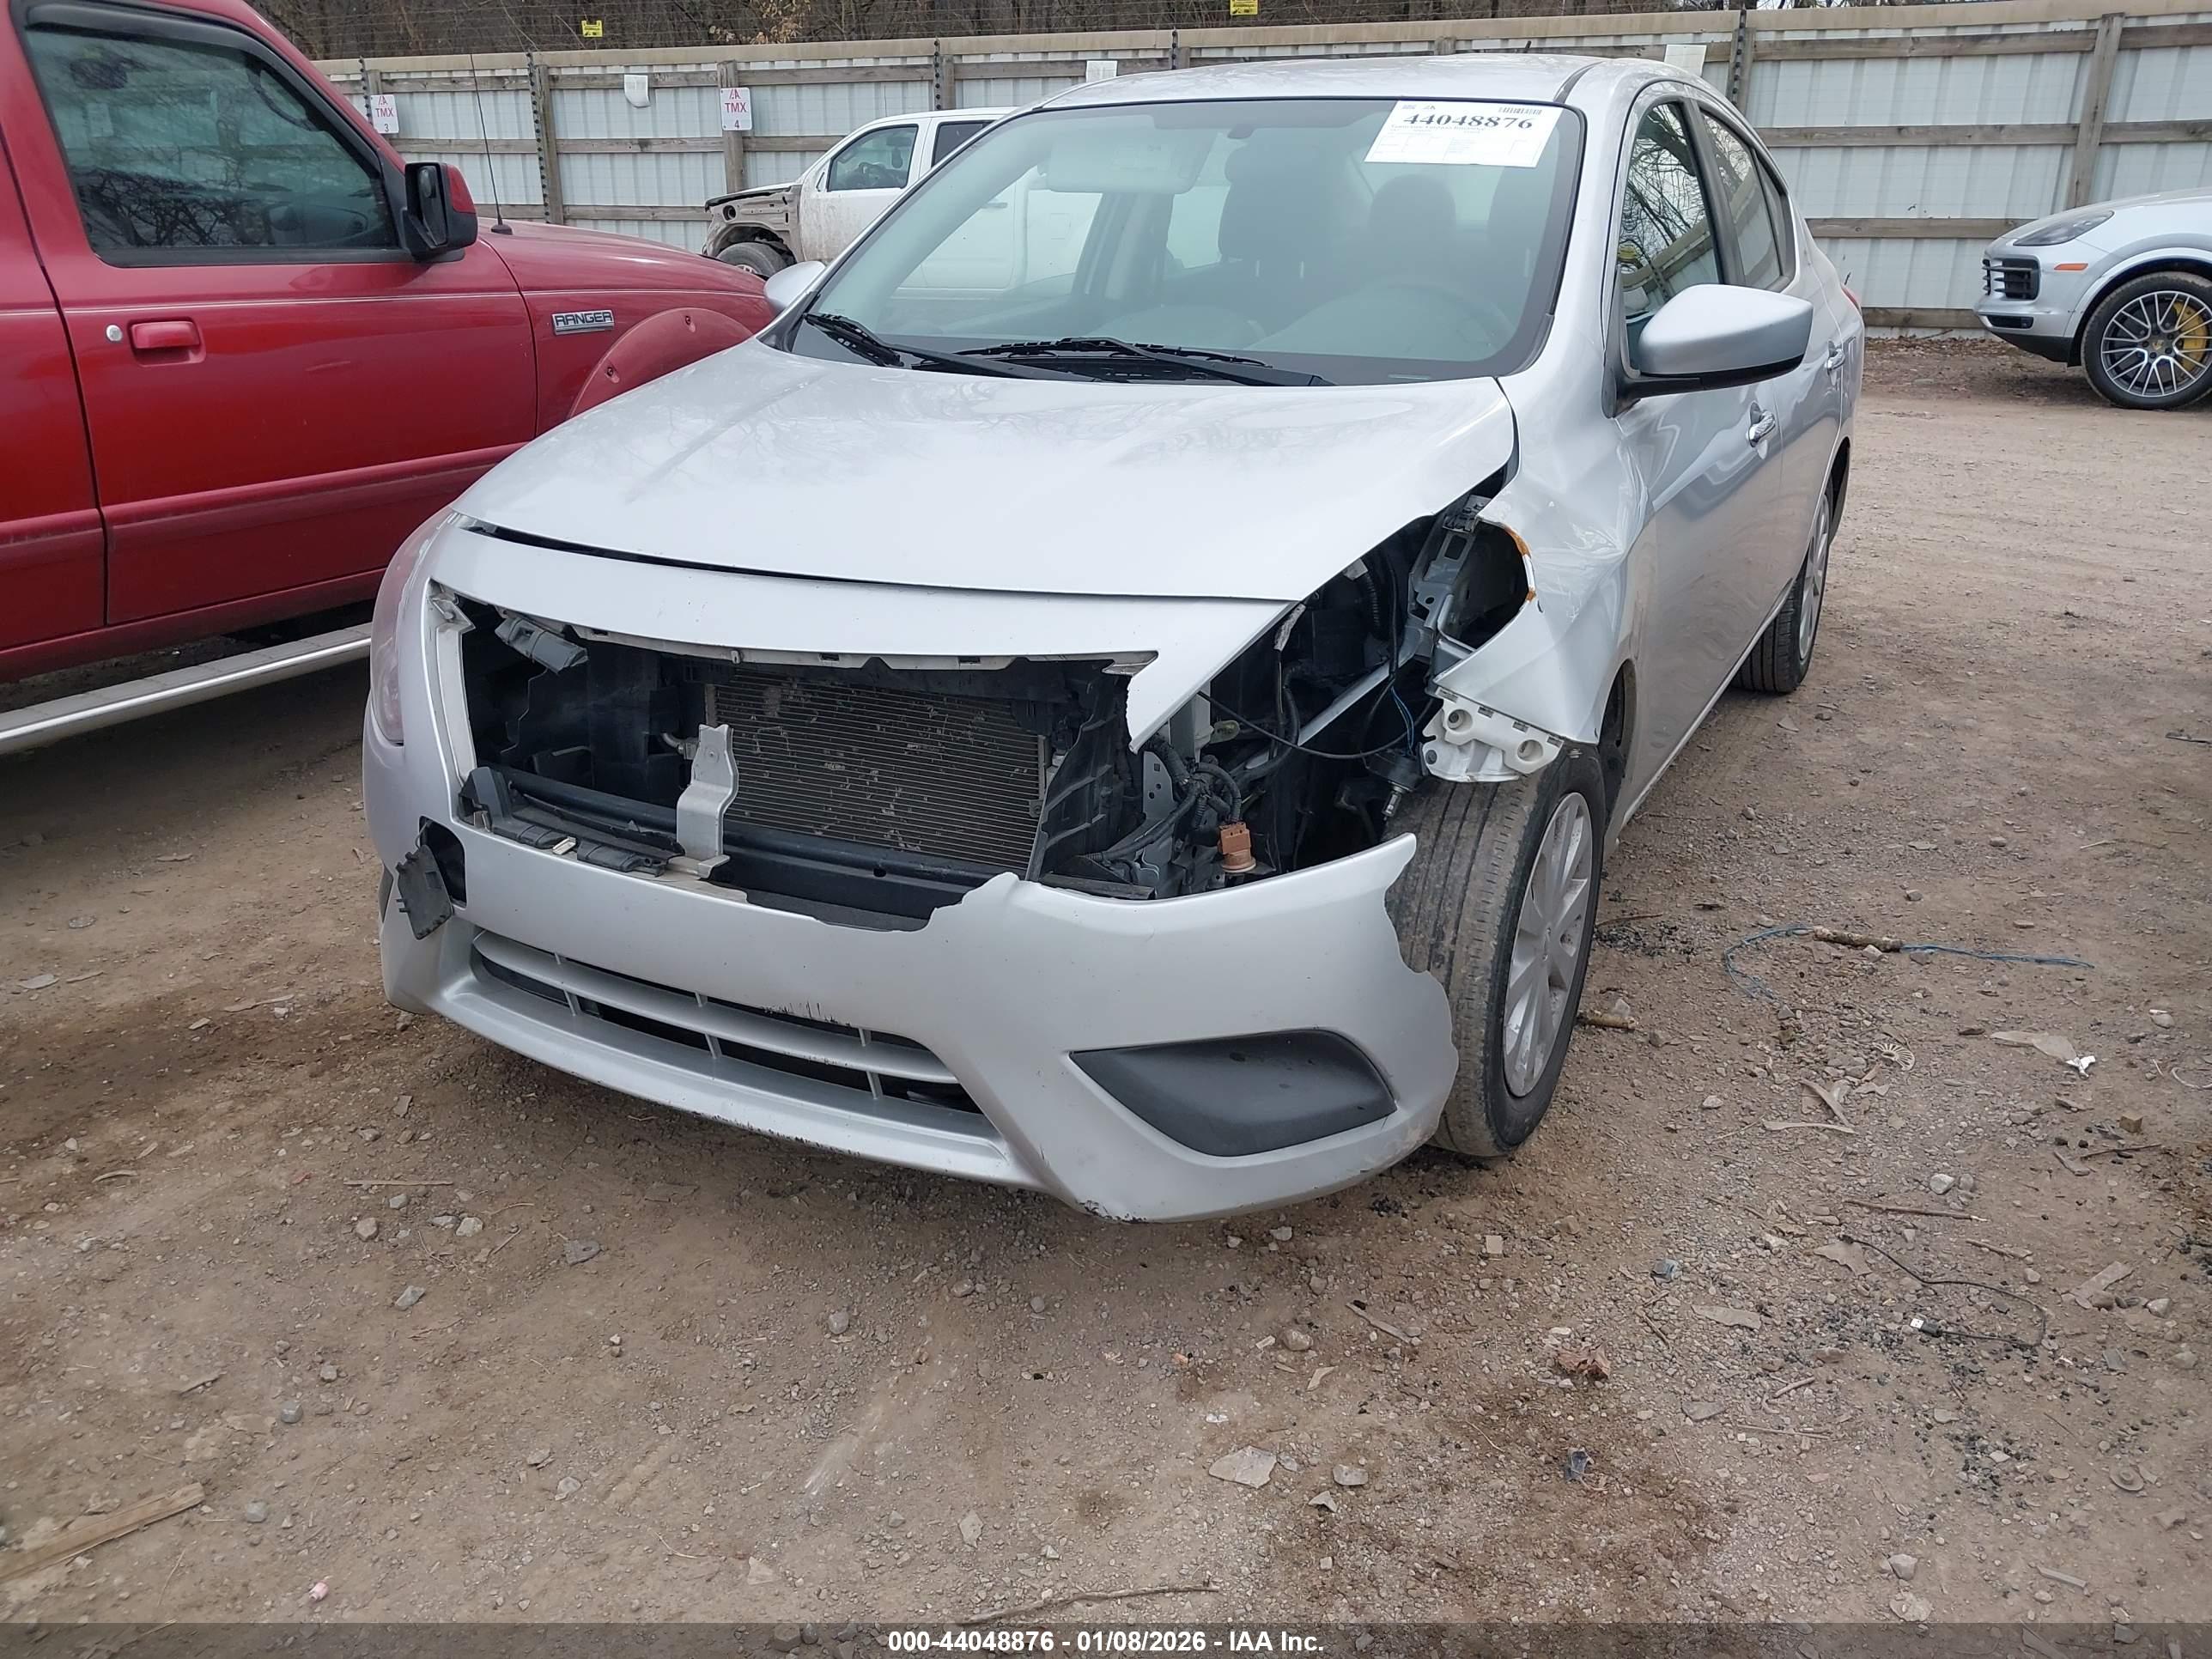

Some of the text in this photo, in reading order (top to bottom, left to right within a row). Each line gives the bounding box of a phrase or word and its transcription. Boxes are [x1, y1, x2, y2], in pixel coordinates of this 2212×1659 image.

[375, 107, 394, 118] TMX
[725, 102, 747, 113] TMX
[384, 123, 390, 132] 3
[734, 118, 740, 129] 4
[1403, 113, 1534, 131] 44048876
[554, 311, 613, 326] RANGER
